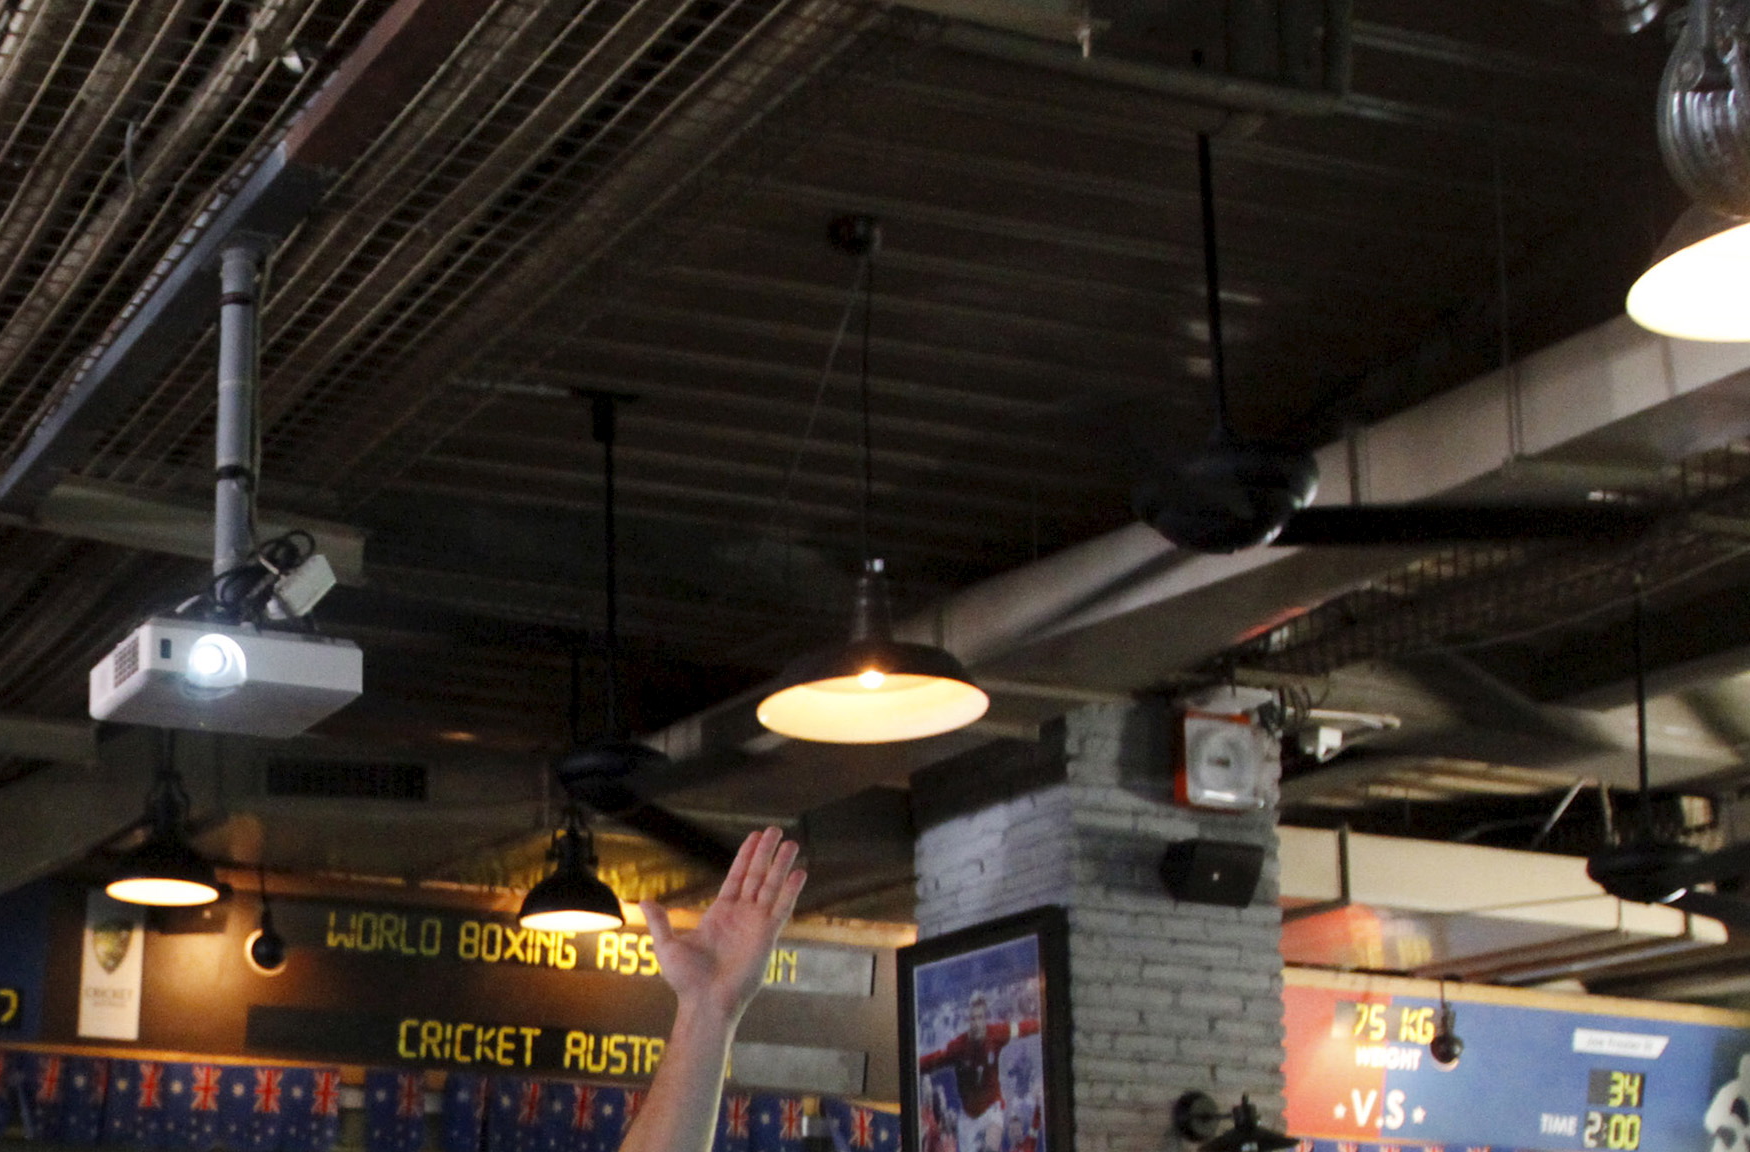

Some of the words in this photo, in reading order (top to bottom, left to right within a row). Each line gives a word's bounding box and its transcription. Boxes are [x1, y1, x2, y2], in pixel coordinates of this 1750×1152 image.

[326, 910, 441, 957] WORLD
[458, 921, 577, 970] BOXING
[1353, 1002, 1387, 1041] 75
[1399, 1006, 1436, 1044] KG
[399, 1019, 542, 1067] CRICKET
[1355, 1046, 1422, 1071] WEIGHT
[1608, 1071, 1641, 1108] 34
[1541, 1112, 1578, 1137] TIME
